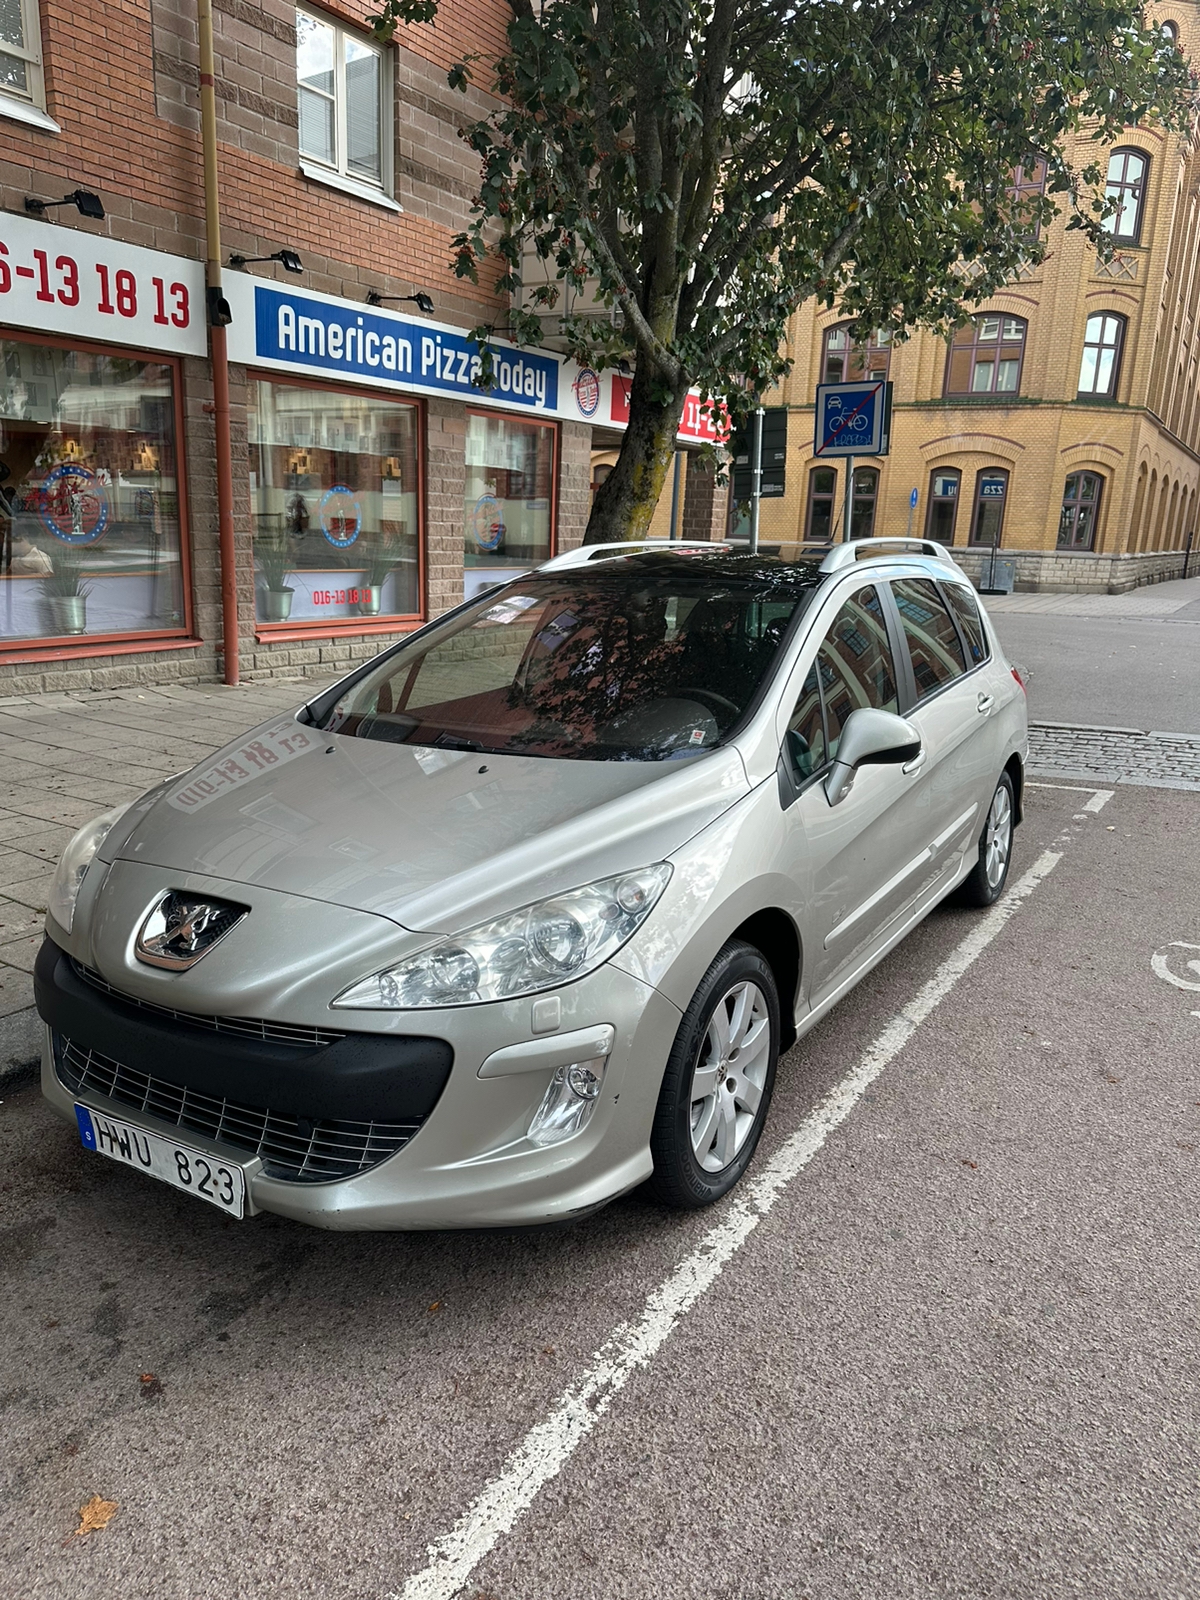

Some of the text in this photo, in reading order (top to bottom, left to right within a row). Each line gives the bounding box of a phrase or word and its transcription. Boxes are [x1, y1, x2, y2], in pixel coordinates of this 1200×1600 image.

[95, 263, 138, 318] 18
[152, 276, 190, 329] 13
[278, 304, 412, 373] American
[421, 335, 482, 388] Pizza
[313, 589, 345, 605] 016-13
[347, 589, 359, 604] 18
[85, 1131, 92, 1141] S
[94, 1116, 234, 1205] HWU 823
